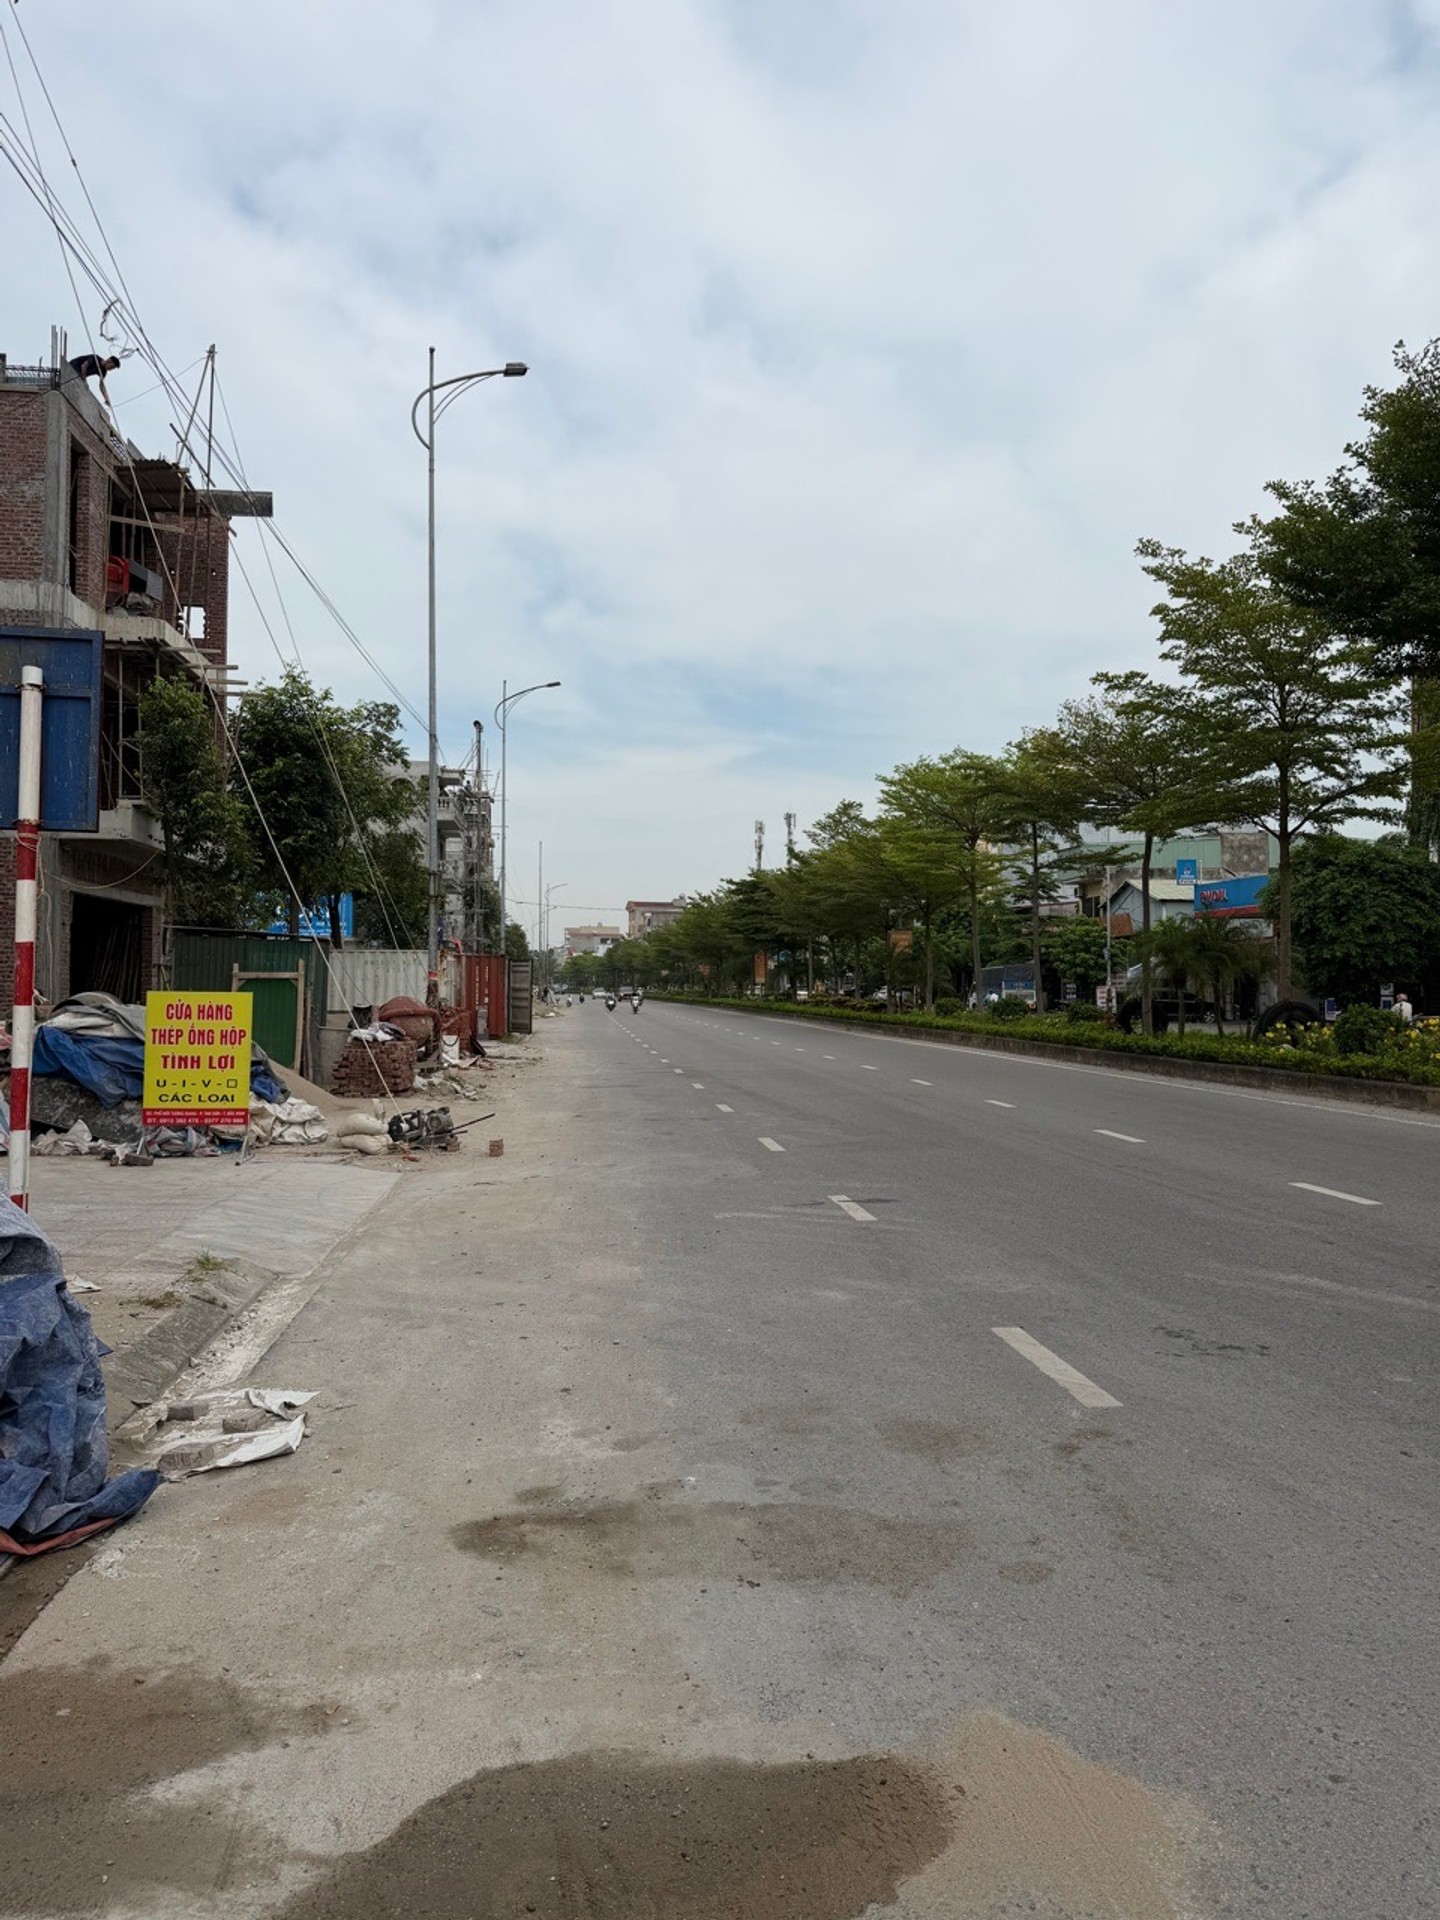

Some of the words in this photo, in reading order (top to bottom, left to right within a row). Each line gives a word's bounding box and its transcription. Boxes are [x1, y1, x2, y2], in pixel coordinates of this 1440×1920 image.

[166, 999, 192, 1020] CỬA
[197, 1001, 233, 1020] HÀNG
[151, 1025, 183, 1045] THÉP
[188, 1022, 214, 1045] ỐNG
[220, 1026, 246, 1049] HỘP
[208, 1054, 235, 1072] LỢI
[158, 1092, 192, 1103] CÁC
[198, 1093, 235, 1104] LOẠI
